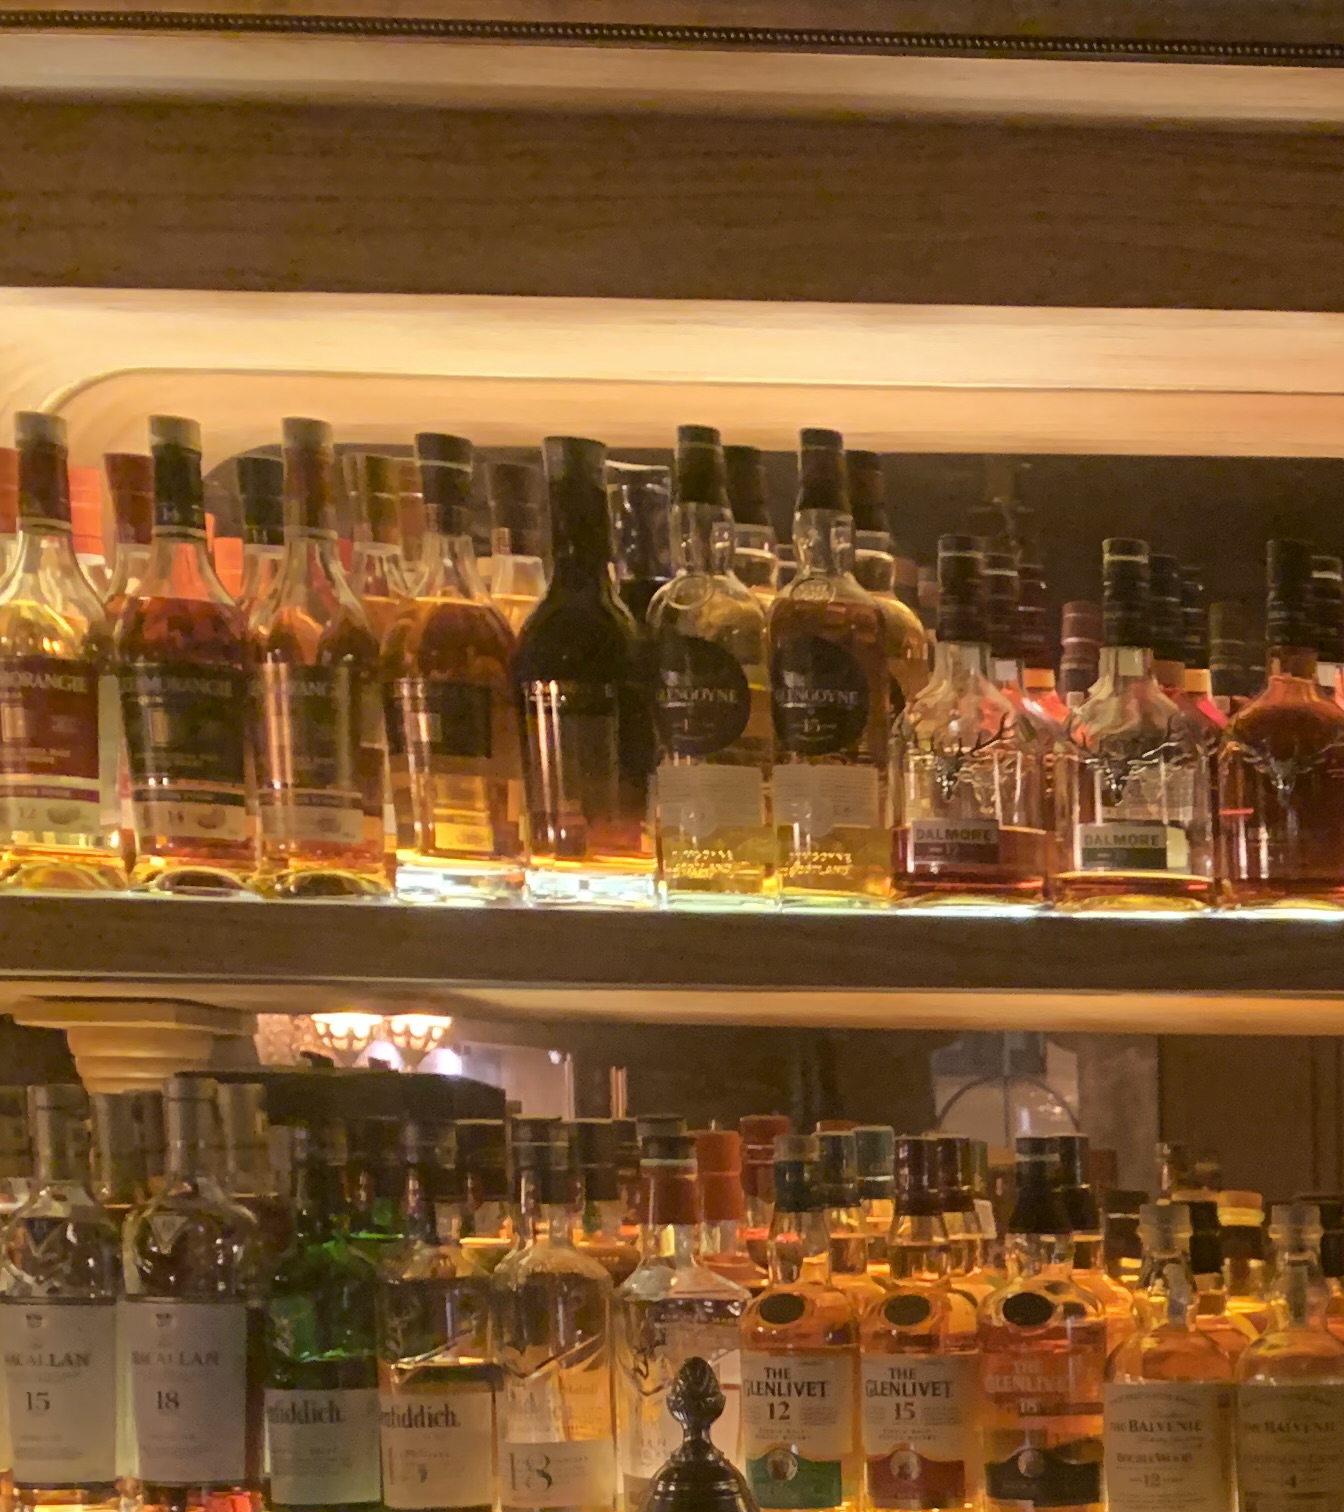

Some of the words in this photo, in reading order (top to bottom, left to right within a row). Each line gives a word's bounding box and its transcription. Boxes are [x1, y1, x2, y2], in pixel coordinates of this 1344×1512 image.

[916, 828, 991, 841] DALMORE
[1084, 834, 1159, 845] DALMORE
[764, 1368, 791, 1380] THE
[888, 1368, 917, 1380] THE
[743, 1380, 828, 1398] GLENLIVET
[865, 1380, 954, 1398] GLENLIVET
[26, 1391, 51, 1411] 15
[156, 1390, 180, 1410] 18
[767, 1402, 791, 1420] 12
[894, 1402, 917, 1420] 15
[1128, 1420, 1202, 1432] BALVENIE
